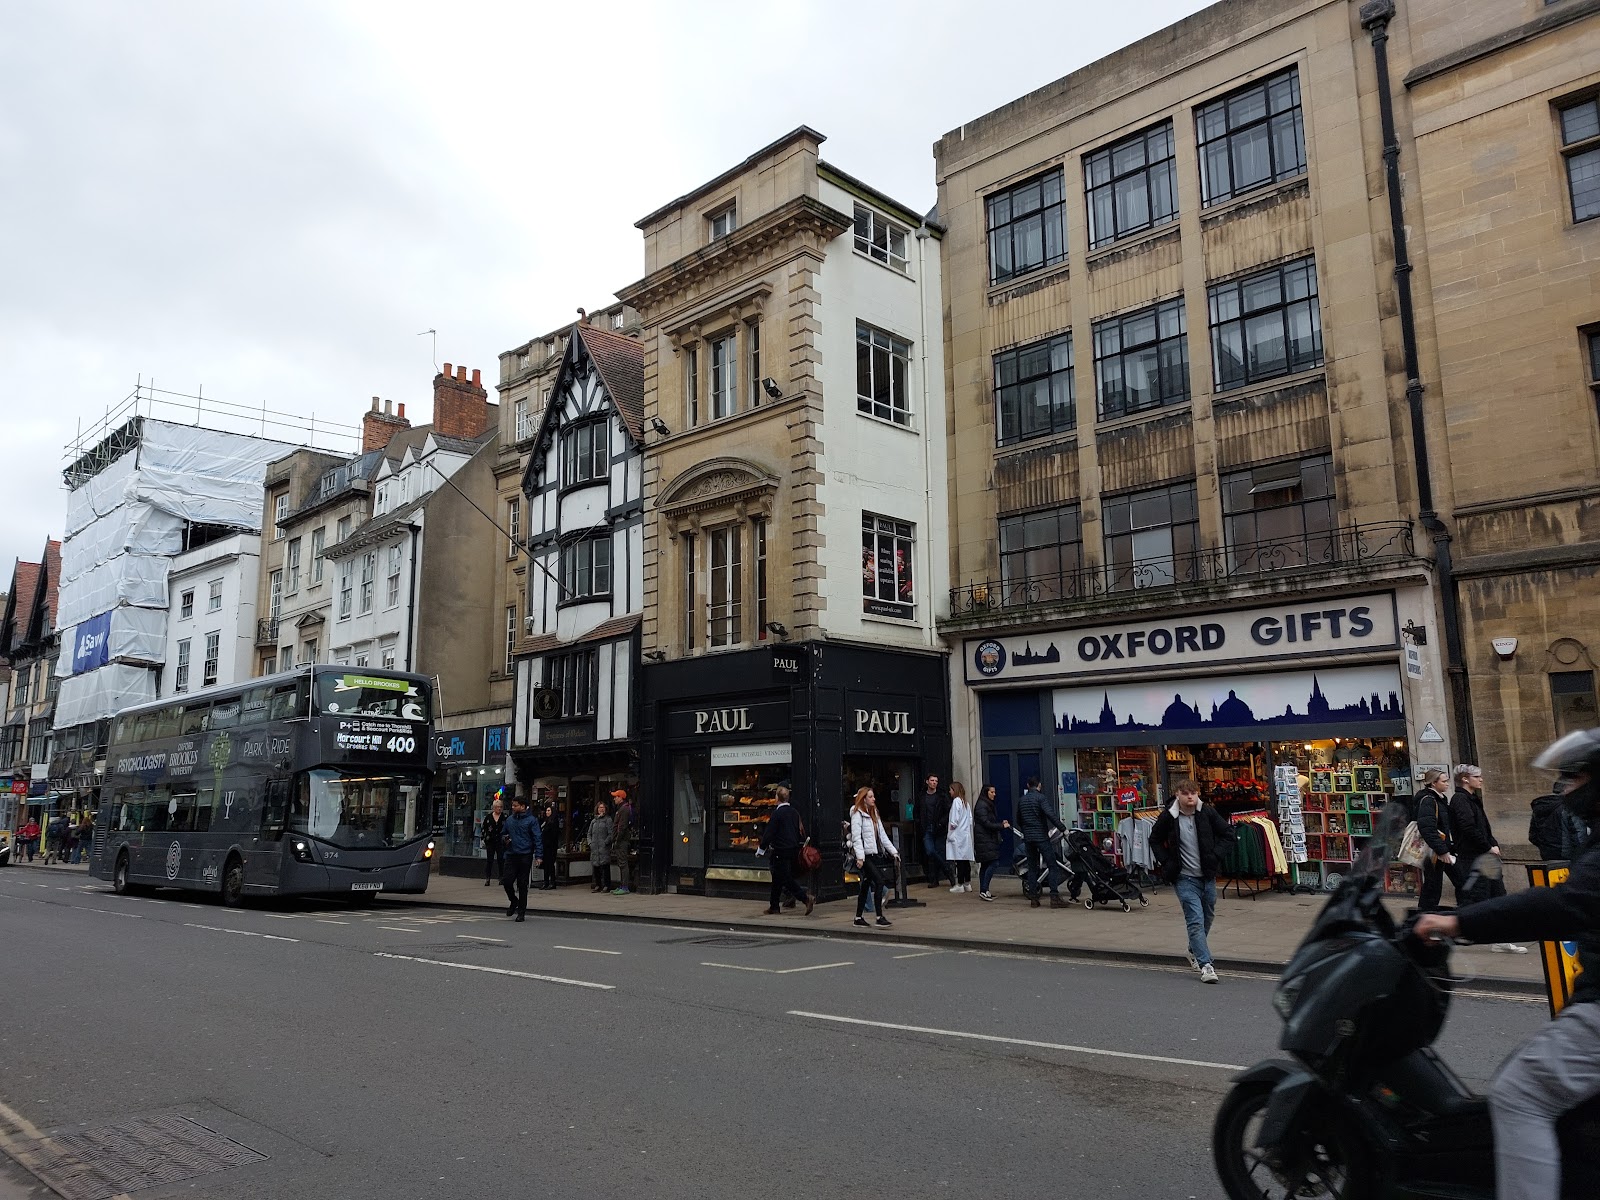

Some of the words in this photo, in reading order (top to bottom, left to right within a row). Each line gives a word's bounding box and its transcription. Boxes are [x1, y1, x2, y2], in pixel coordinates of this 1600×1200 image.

[1077, 623, 1226, 662] OXFORD
[1251, 606, 1374, 646] GIFTS
[980, 643, 1000, 652] OXFORD
[773, 657, 799, 670] PAUL
[373, 681, 400, 689] BROOKES
[694, 707, 754, 734] PAUL
[854, 709, 916, 735] PAUL
[243, 741, 264, 757] PARK
[270, 738, 291, 755] RIDE
[337, 732, 371, 744] Harcourt
[371, 735, 383, 745] Hill
[386, 736, 416, 754] 400
[117, 753, 166, 773] PSYCHOLOGIST?
[169, 750, 199, 767] BROOKES
[170, 765, 194, 776] UNIVERSITY
[324, 851, 339, 859] 374
